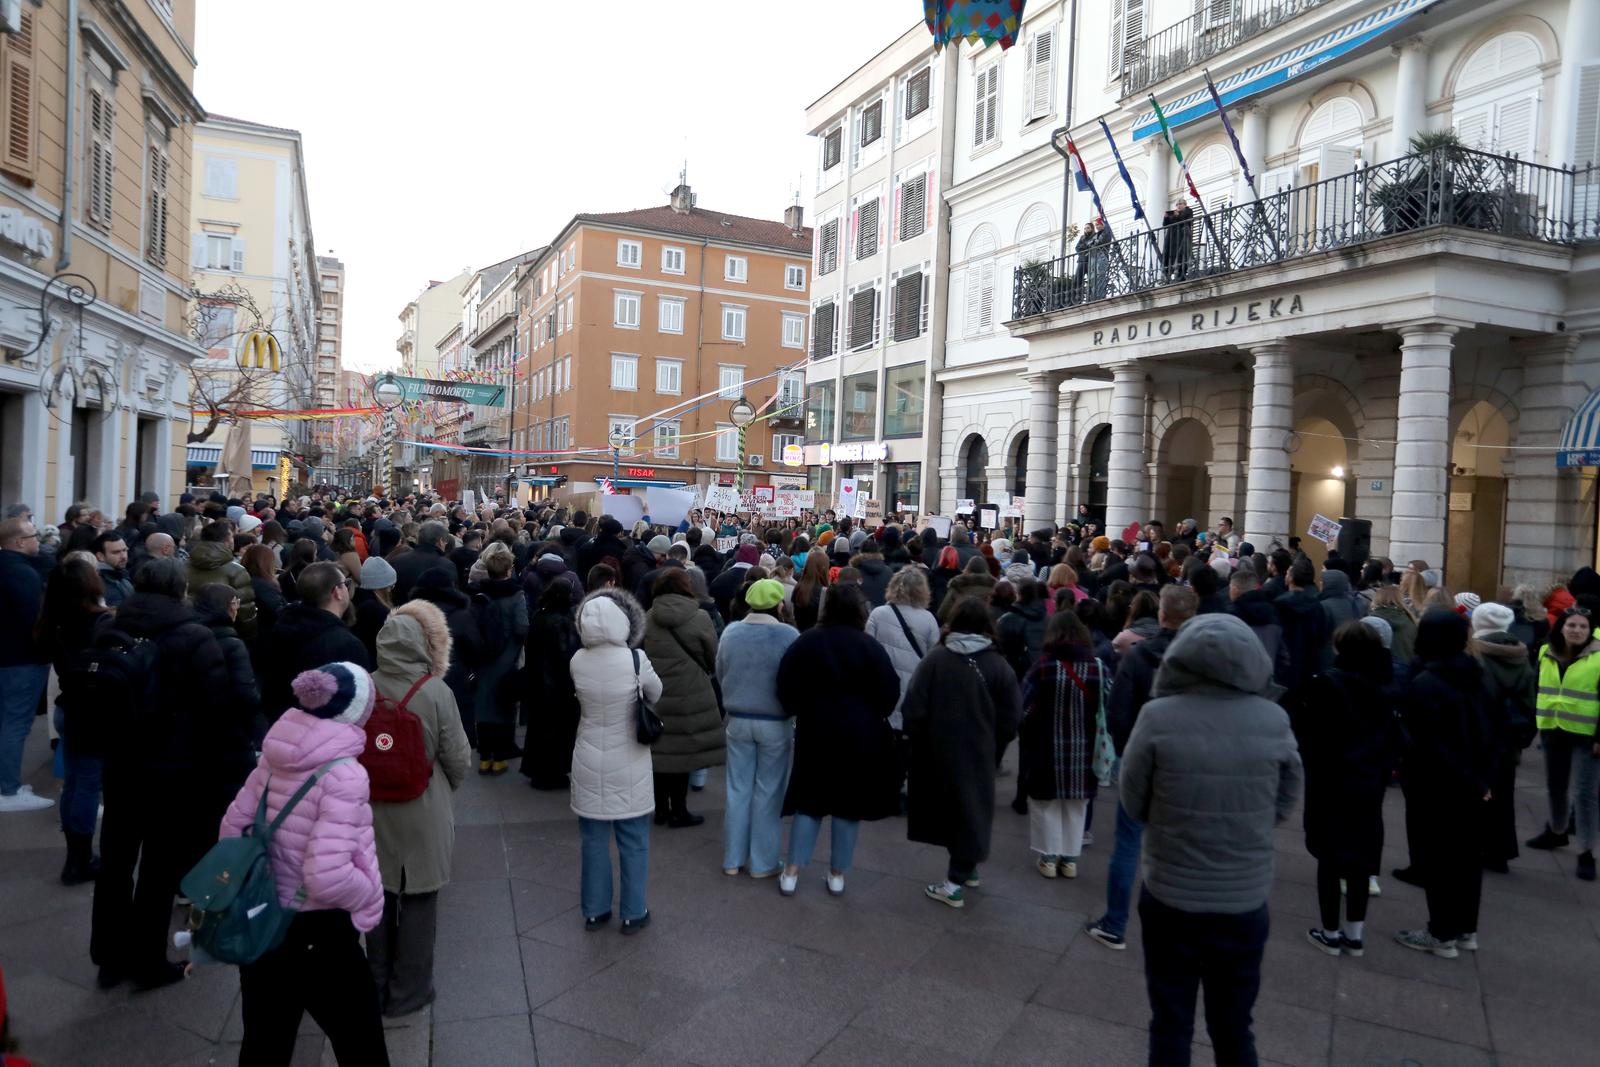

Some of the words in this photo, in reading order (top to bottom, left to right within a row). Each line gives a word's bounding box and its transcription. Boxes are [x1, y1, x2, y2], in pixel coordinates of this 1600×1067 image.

[1093, 319, 1172, 346] RADIO
[1191, 294, 1304, 331] RIJEKA
[407, 382, 436, 396] FIUME
[441, 386, 475, 398] MORTE!
[628, 468, 655, 477] TISAK
